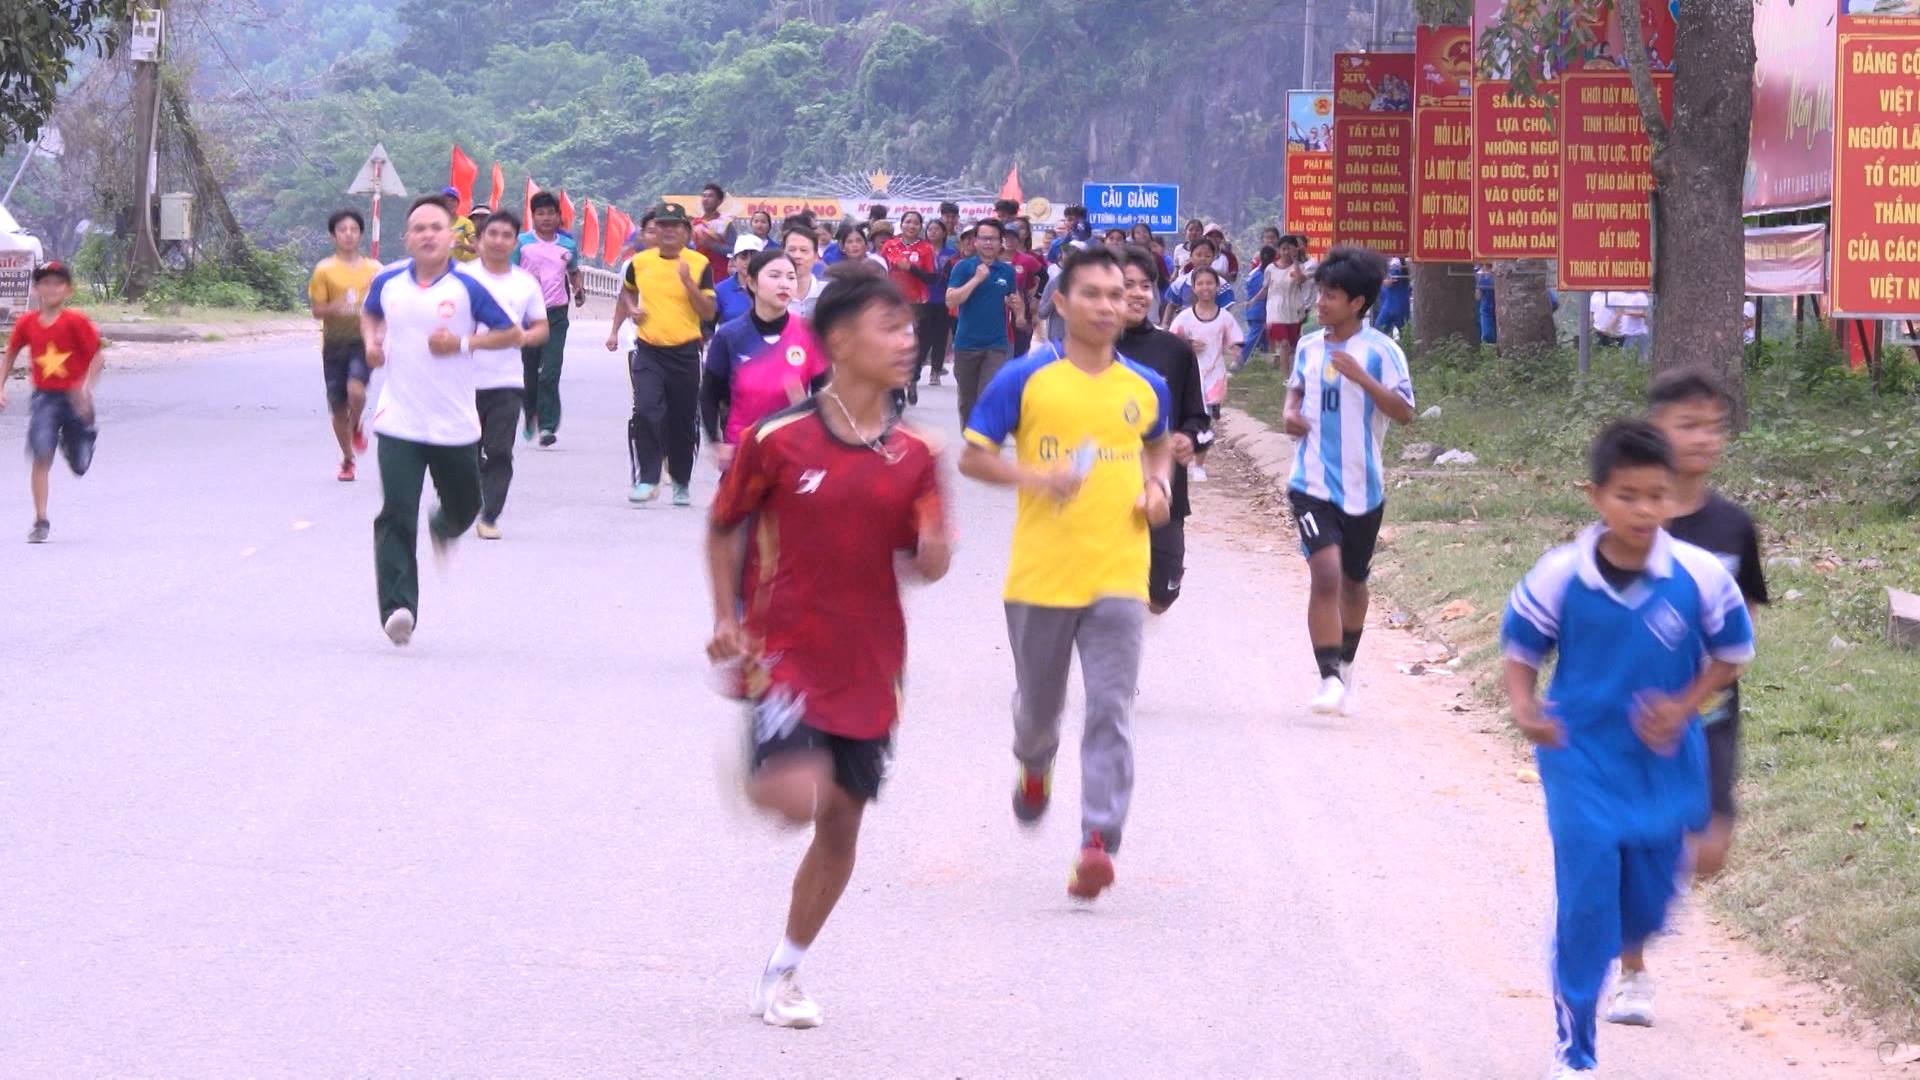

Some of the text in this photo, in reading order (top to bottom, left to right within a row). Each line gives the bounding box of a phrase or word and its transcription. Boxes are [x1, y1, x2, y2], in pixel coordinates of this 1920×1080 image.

[1852, 43, 1920, 79] ĐẢNG CỘ
[1879, 85, 1914, 117] VIỆT
[1496, 116, 1519, 135] LỰA
[1848, 121, 1920, 149] NGƯỜI LÃ
[1484, 139, 1527, 155] NHỮNG
[1481, 160, 1498, 178] ĐỦ
[1532, 160, 1549, 178] ĐỦ
[1888, 161, 1920, 187] CHỨ
[1101, 187, 1122, 208] CẦU
[1484, 186, 1508, 202] VÀO
[1512, 184, 1544, 203] QUỐC
[1488, 207, 1558, 228] VÀ HỘI ĐỒN
[1492, 231, 1527, 248] NHÂN
[1847, 231, 1880, 262] CỦA
[1884, 235, 1920, 262] CÁC
[1569, 261, 1597, 277] TRONG
[1869, 272, 1920, 304] VIỆT N
[1321, 388, 1339, 412] 10
[1300, 511, 1320, 538] 11
